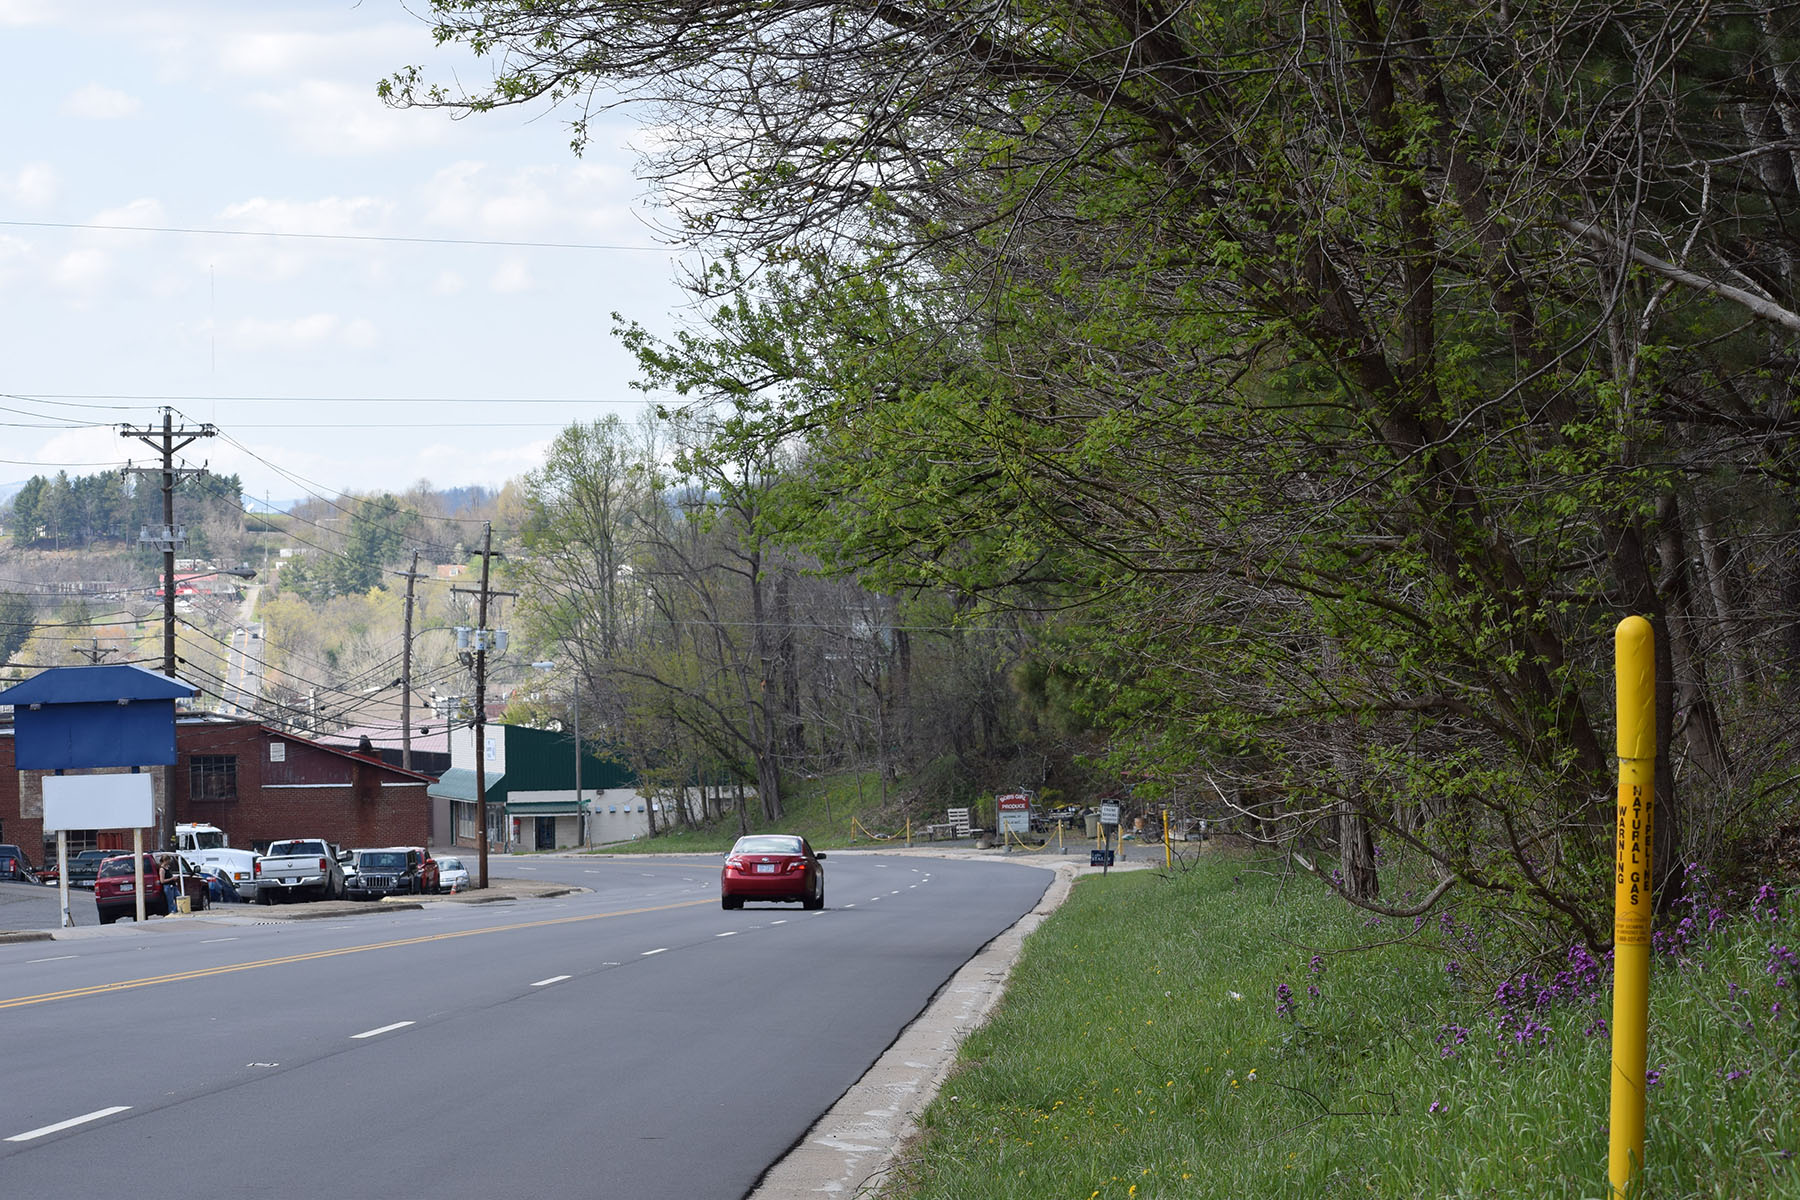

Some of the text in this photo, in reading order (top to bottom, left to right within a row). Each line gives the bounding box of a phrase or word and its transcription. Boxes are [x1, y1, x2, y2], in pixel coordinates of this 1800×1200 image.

[1617, 806, 1627, 884] WARNING
[1630, 785, 1642, 905] NATURAL GAS
[1644, 802, 1652, 891] PIPELINE
